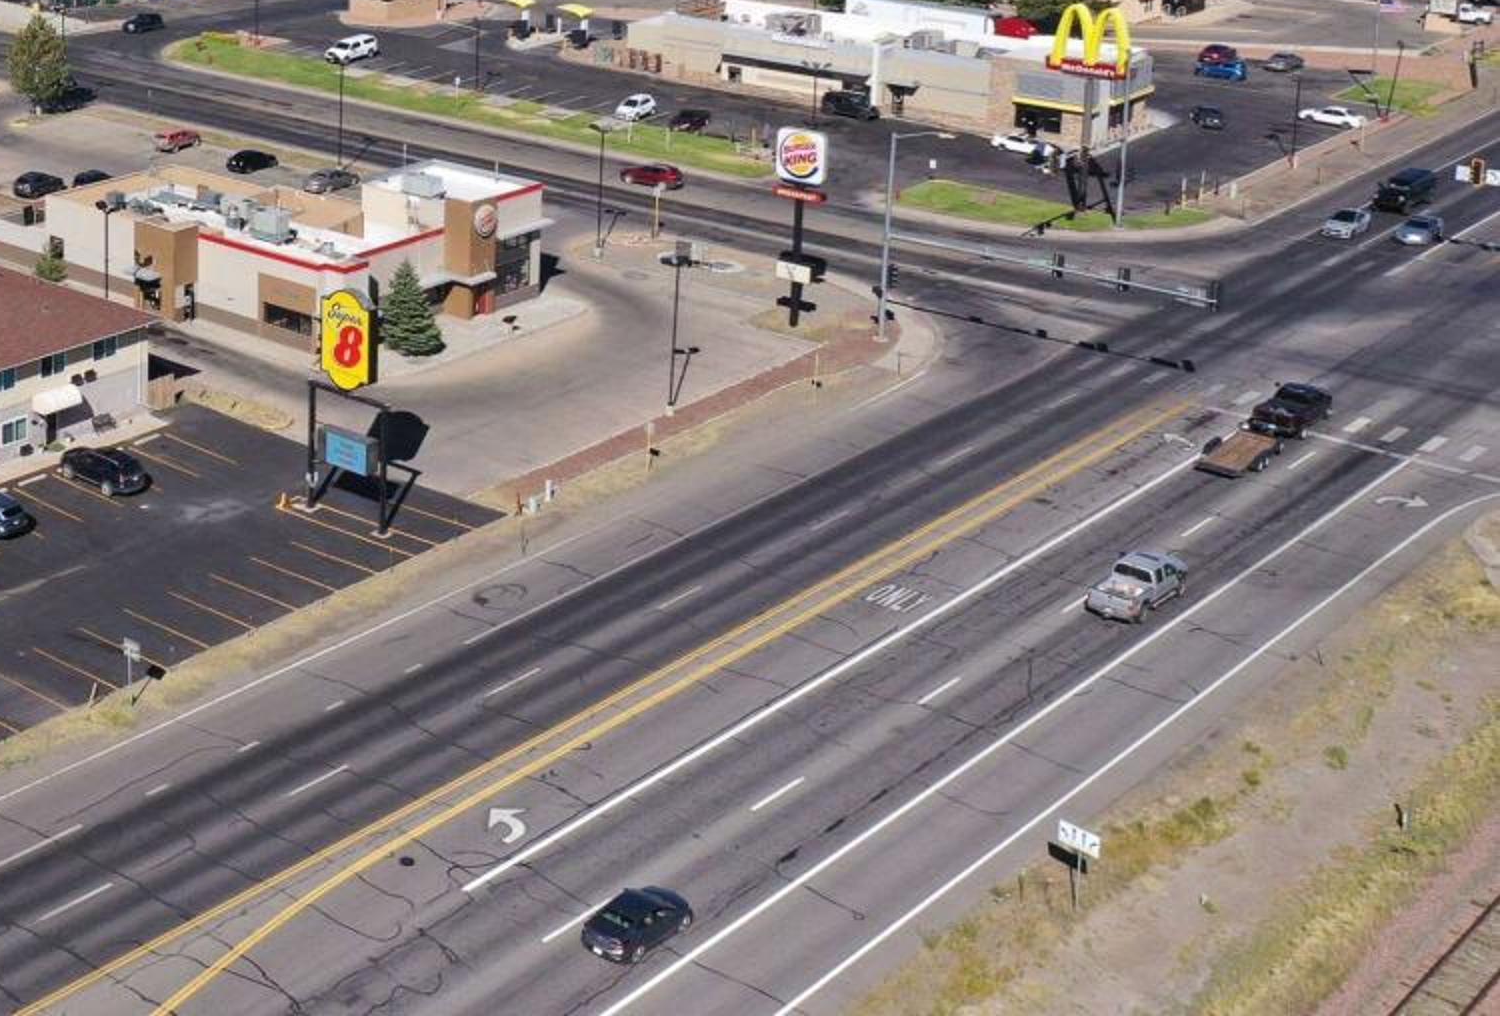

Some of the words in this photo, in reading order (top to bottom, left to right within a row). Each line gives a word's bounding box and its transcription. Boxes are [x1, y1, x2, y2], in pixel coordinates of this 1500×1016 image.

[783, 152, 818, 167] KING
[327, 302, 363, 329] Super
[334, 326, 363, 369] 8
[866, 584, 933, 613] ONLY
